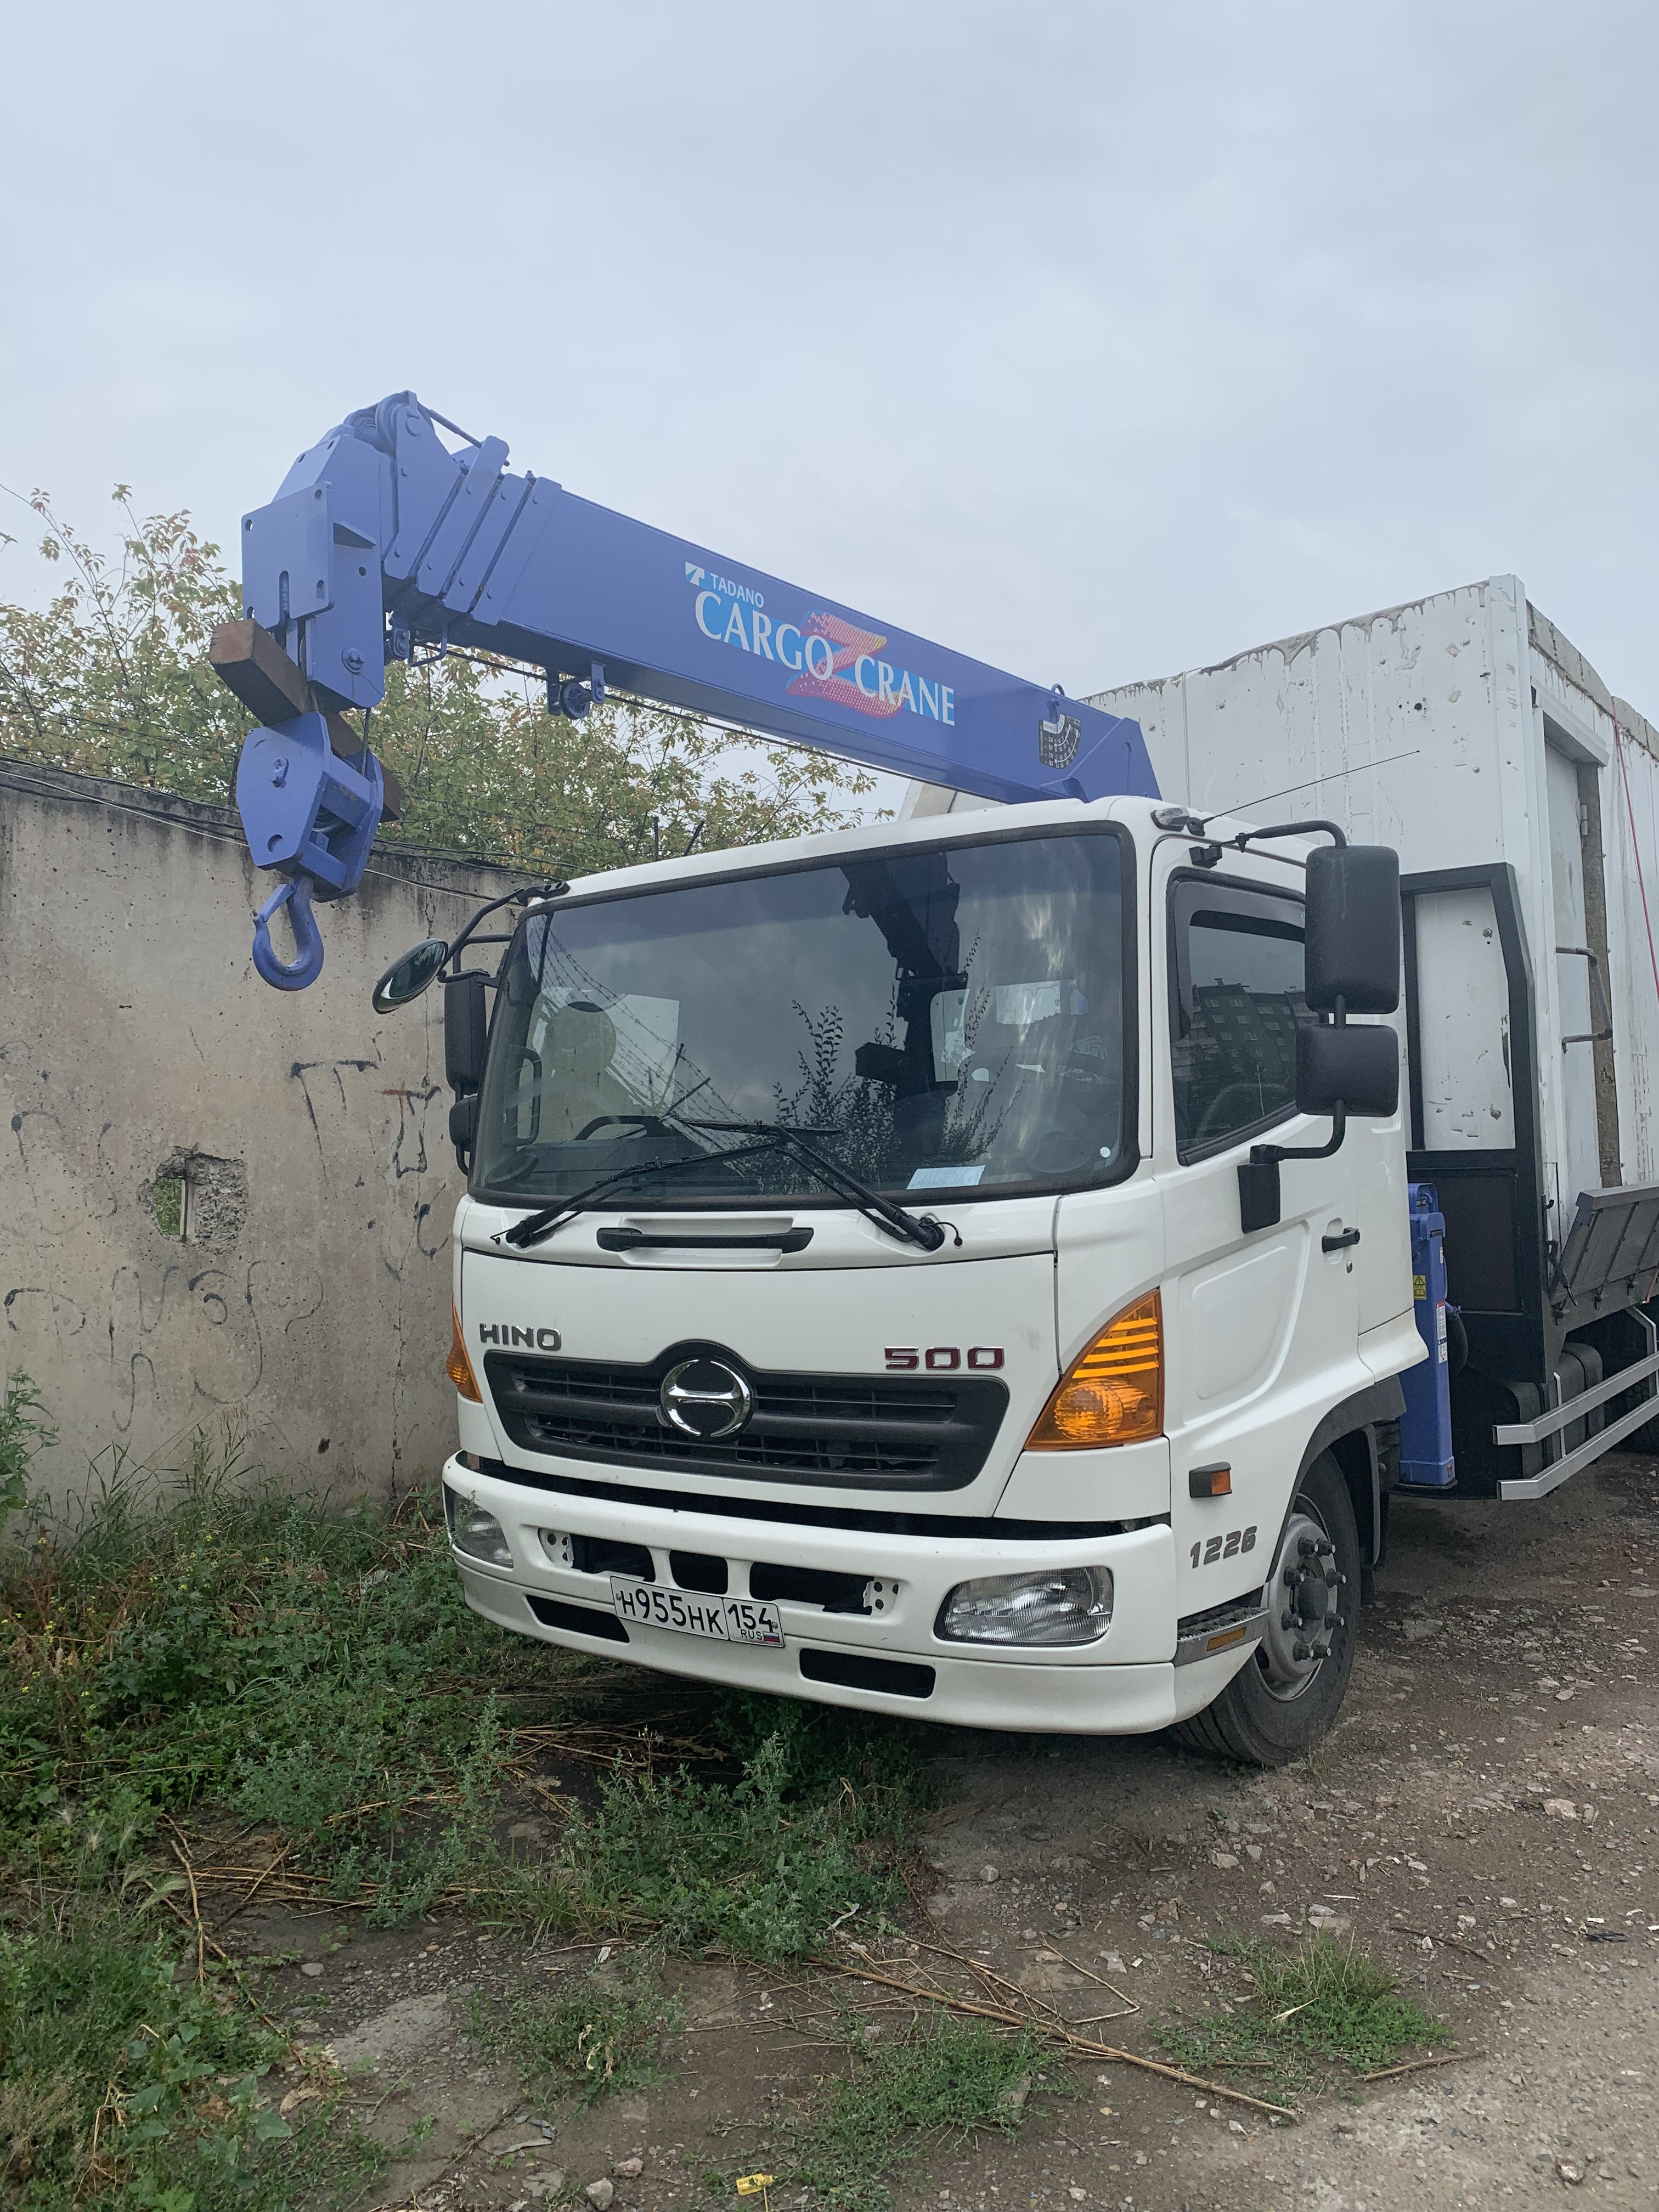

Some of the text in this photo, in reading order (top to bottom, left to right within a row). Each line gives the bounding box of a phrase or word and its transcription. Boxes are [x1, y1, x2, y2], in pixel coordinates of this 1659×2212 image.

[710, 572, 764, 608] TADANO
[695, 591, 833, 680] CARGO
[854, 654, 955, 726] CRANE
[479, 1323, 562, 1351] HINO
[884, 1346, 1005, 1370] 500
[1190, 1526, 1257, 1568] 1226
[727, 1603, 775, 1633] 154
[741, 1629, 763, 1640] RUS
